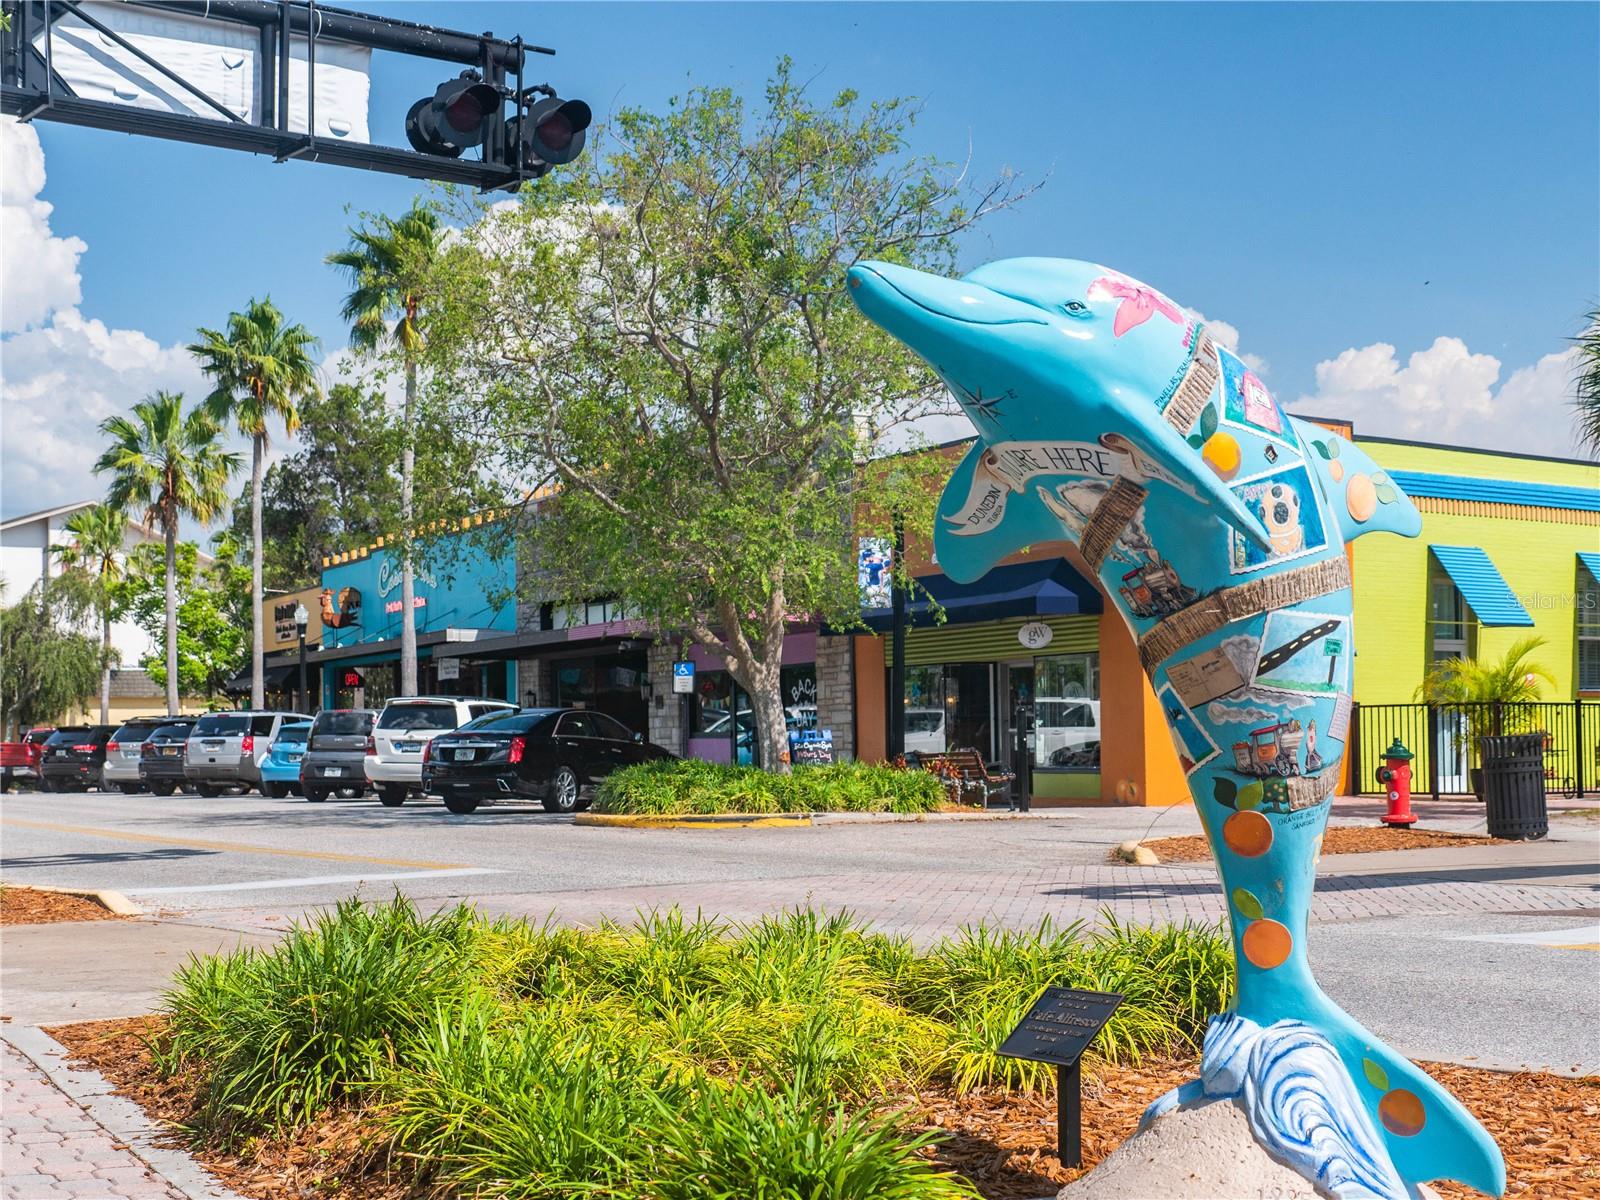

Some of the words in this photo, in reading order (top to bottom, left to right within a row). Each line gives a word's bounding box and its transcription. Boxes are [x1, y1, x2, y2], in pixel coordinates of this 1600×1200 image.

[1154, 376, 1178, 407] PINELLAS
[1042, 447, 1115, 477] HERE
[967, 483, 1001, 526] DUNEDIN
[345, 672, 359, 686] OPEN
[1053, 1011, 1100, 1028] Alfresco
